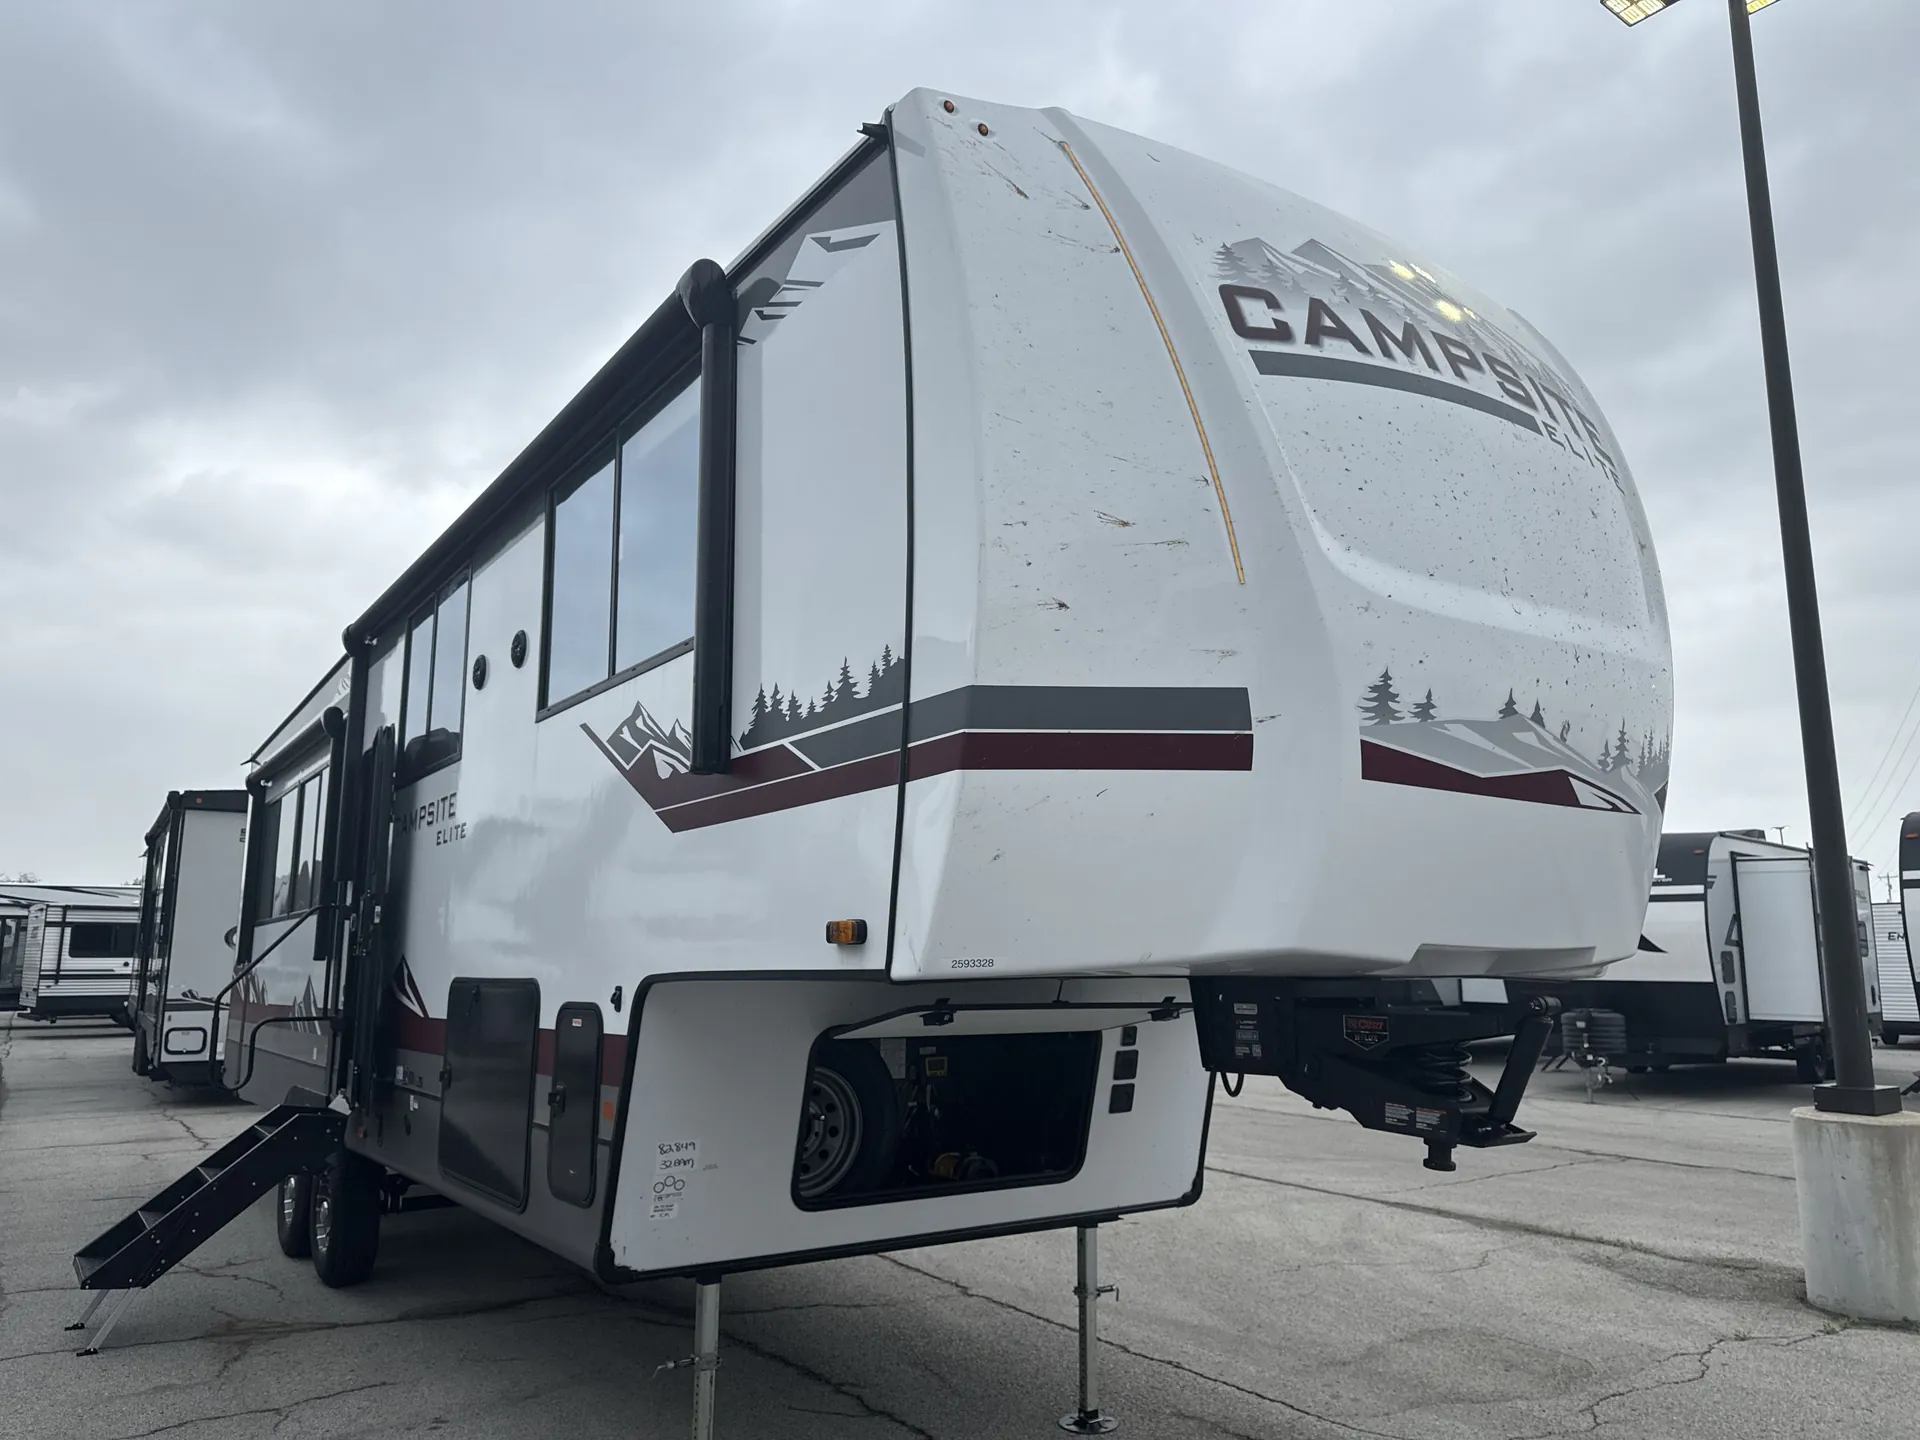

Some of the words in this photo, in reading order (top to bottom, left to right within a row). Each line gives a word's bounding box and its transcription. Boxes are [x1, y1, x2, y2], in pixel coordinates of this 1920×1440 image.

[1217, 283, 1617, 470] CAMPSITE
[1541, 420, 1625, 496] ELITE
[401, 792, 457, 832] AMPSITE
[436, 822, 467, 846] ELITE
[951, 958, 995, 969] 2593328
[658, 1141, 696, 1155] 82849
